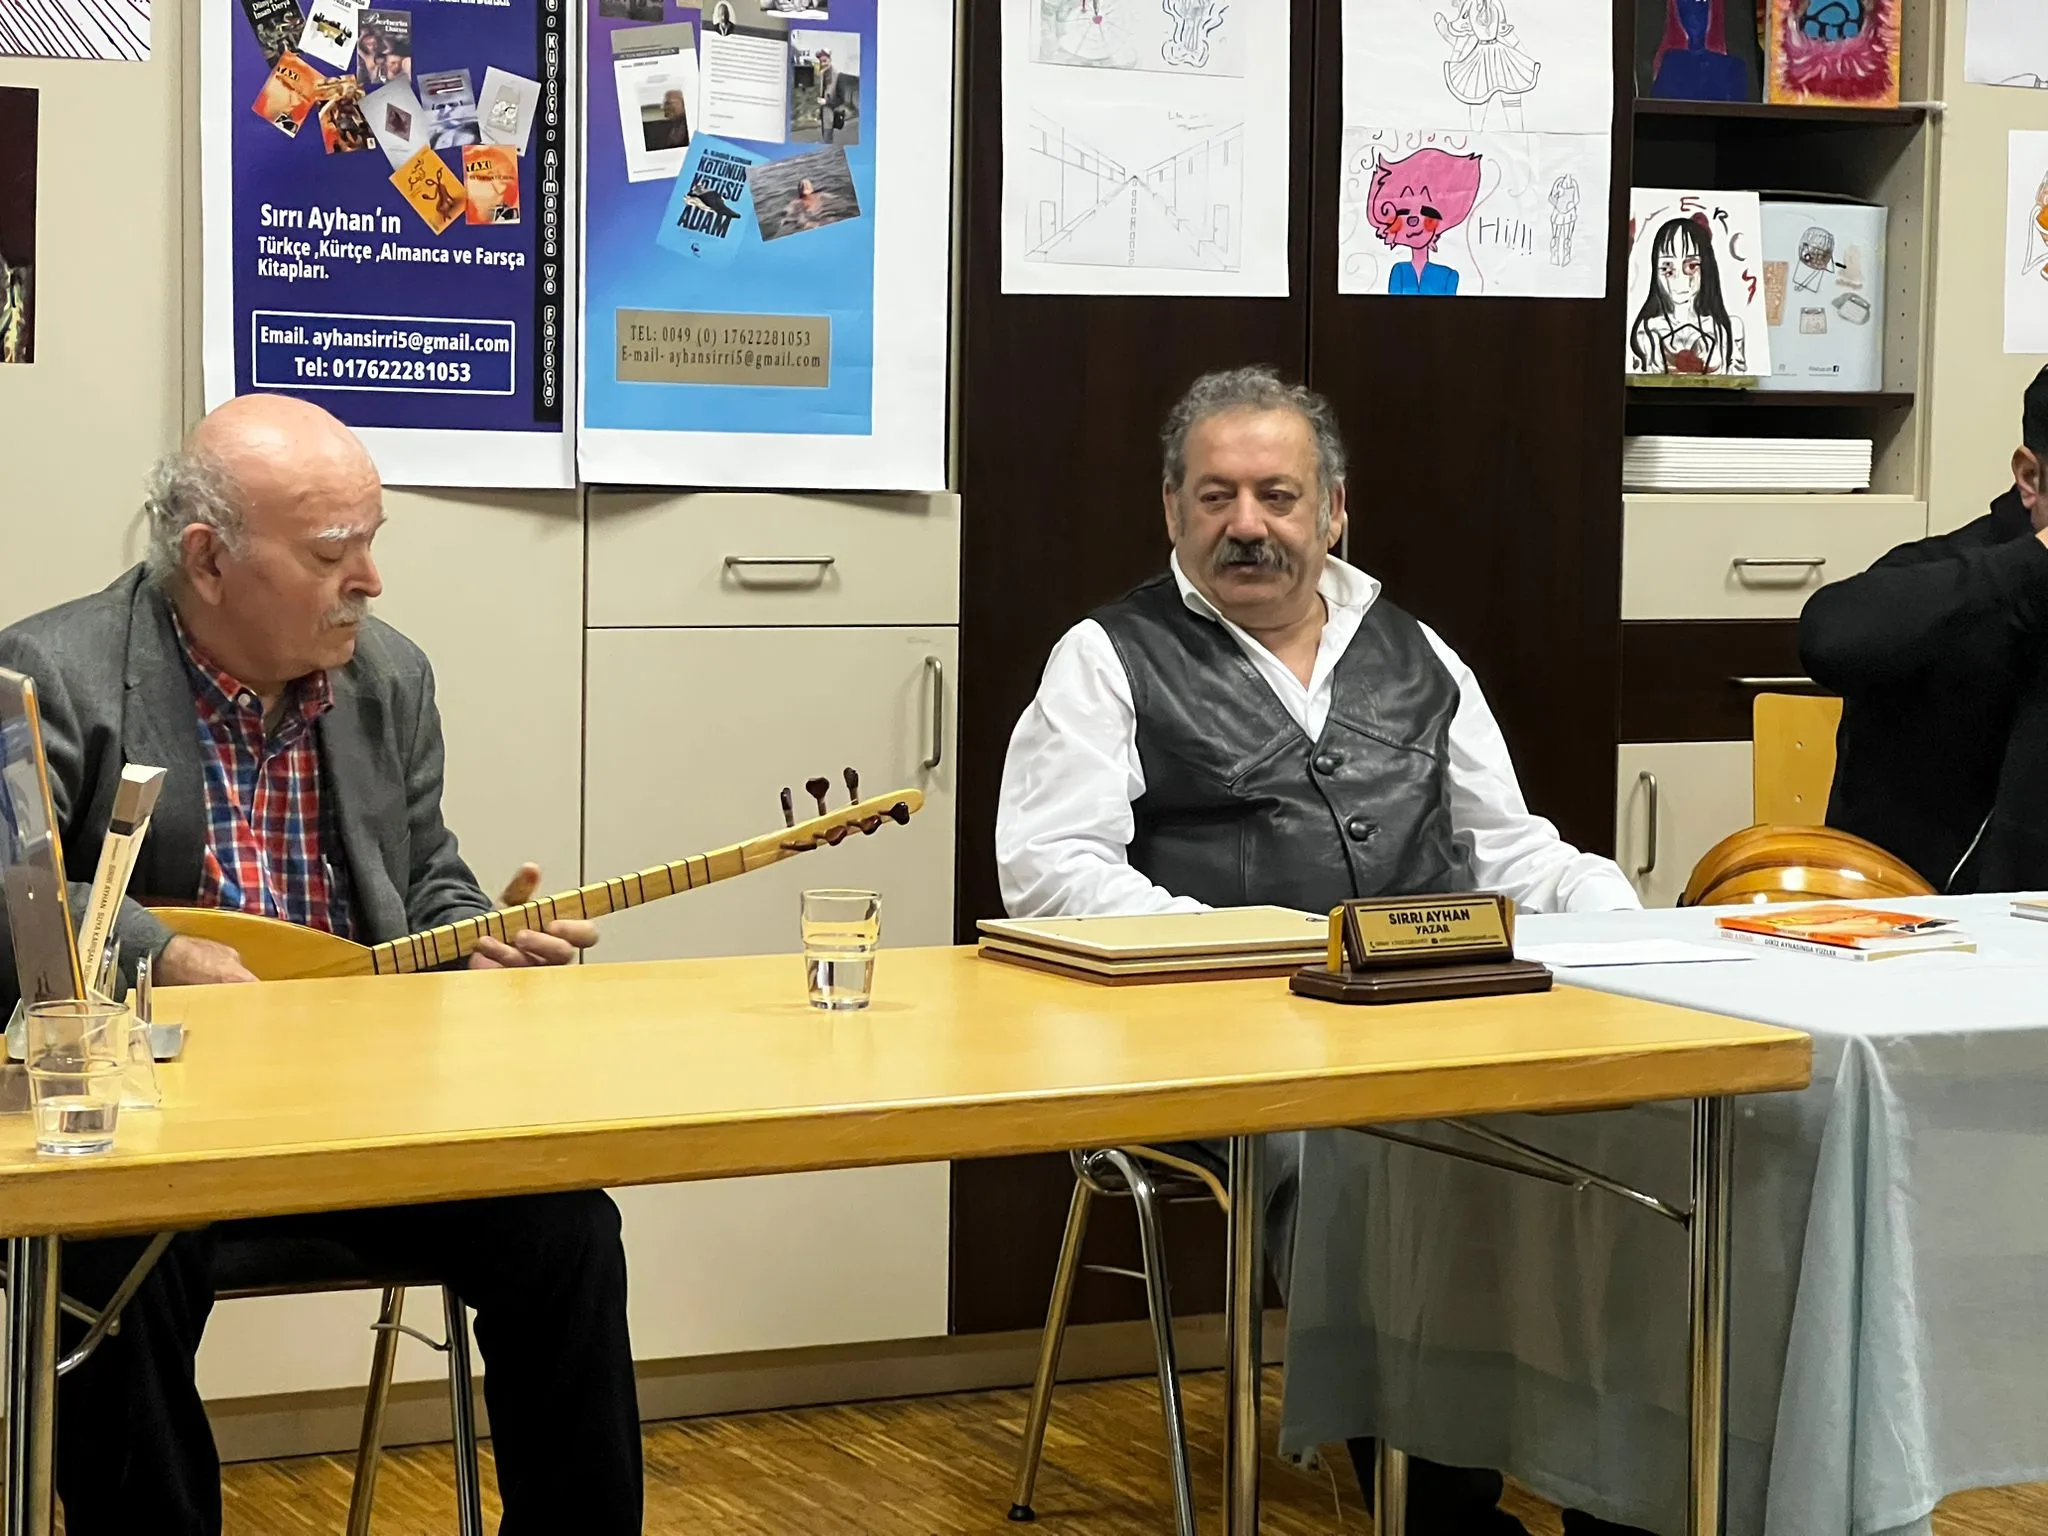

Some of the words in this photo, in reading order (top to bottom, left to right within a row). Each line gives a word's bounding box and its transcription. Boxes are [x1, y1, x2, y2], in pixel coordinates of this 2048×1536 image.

[466, 160, 492, 173] TAXI
[543, 149, 559, 257] Almanca
[261, 203, 303, 228] Sırrı
[308, 206, 401, 236] Ayhan'ın
[258, 236, 311, 260] Türkçe
[453, 249, 471, 264] ve
[476, 247, 525, 271] Farsça
[258, 258, 330, 283] Kitapları.
[543, 263, 557, 295] ve
[260, 326, 309, 345] Email.
[312, 328, 509, 354] ayhansirri5@gmail.com
[630, 324, 657, 342] TEL:
[662, 327, 691, 343] 0049
[697, 328, 718, 347] (0)
[724, 329, 811, 346] 17622281053
[295, 356, 328, 378] Tel:
[332, 358, 471, 382] 017622281053
[669, 349, 821, 369] ayhansirri5@gmail.com
[1389, 909, 1424, 926] SIRRI
[1426, 908, 1470, 924] AYHAN
[1415, 925, 1451, 935] YAZAR
